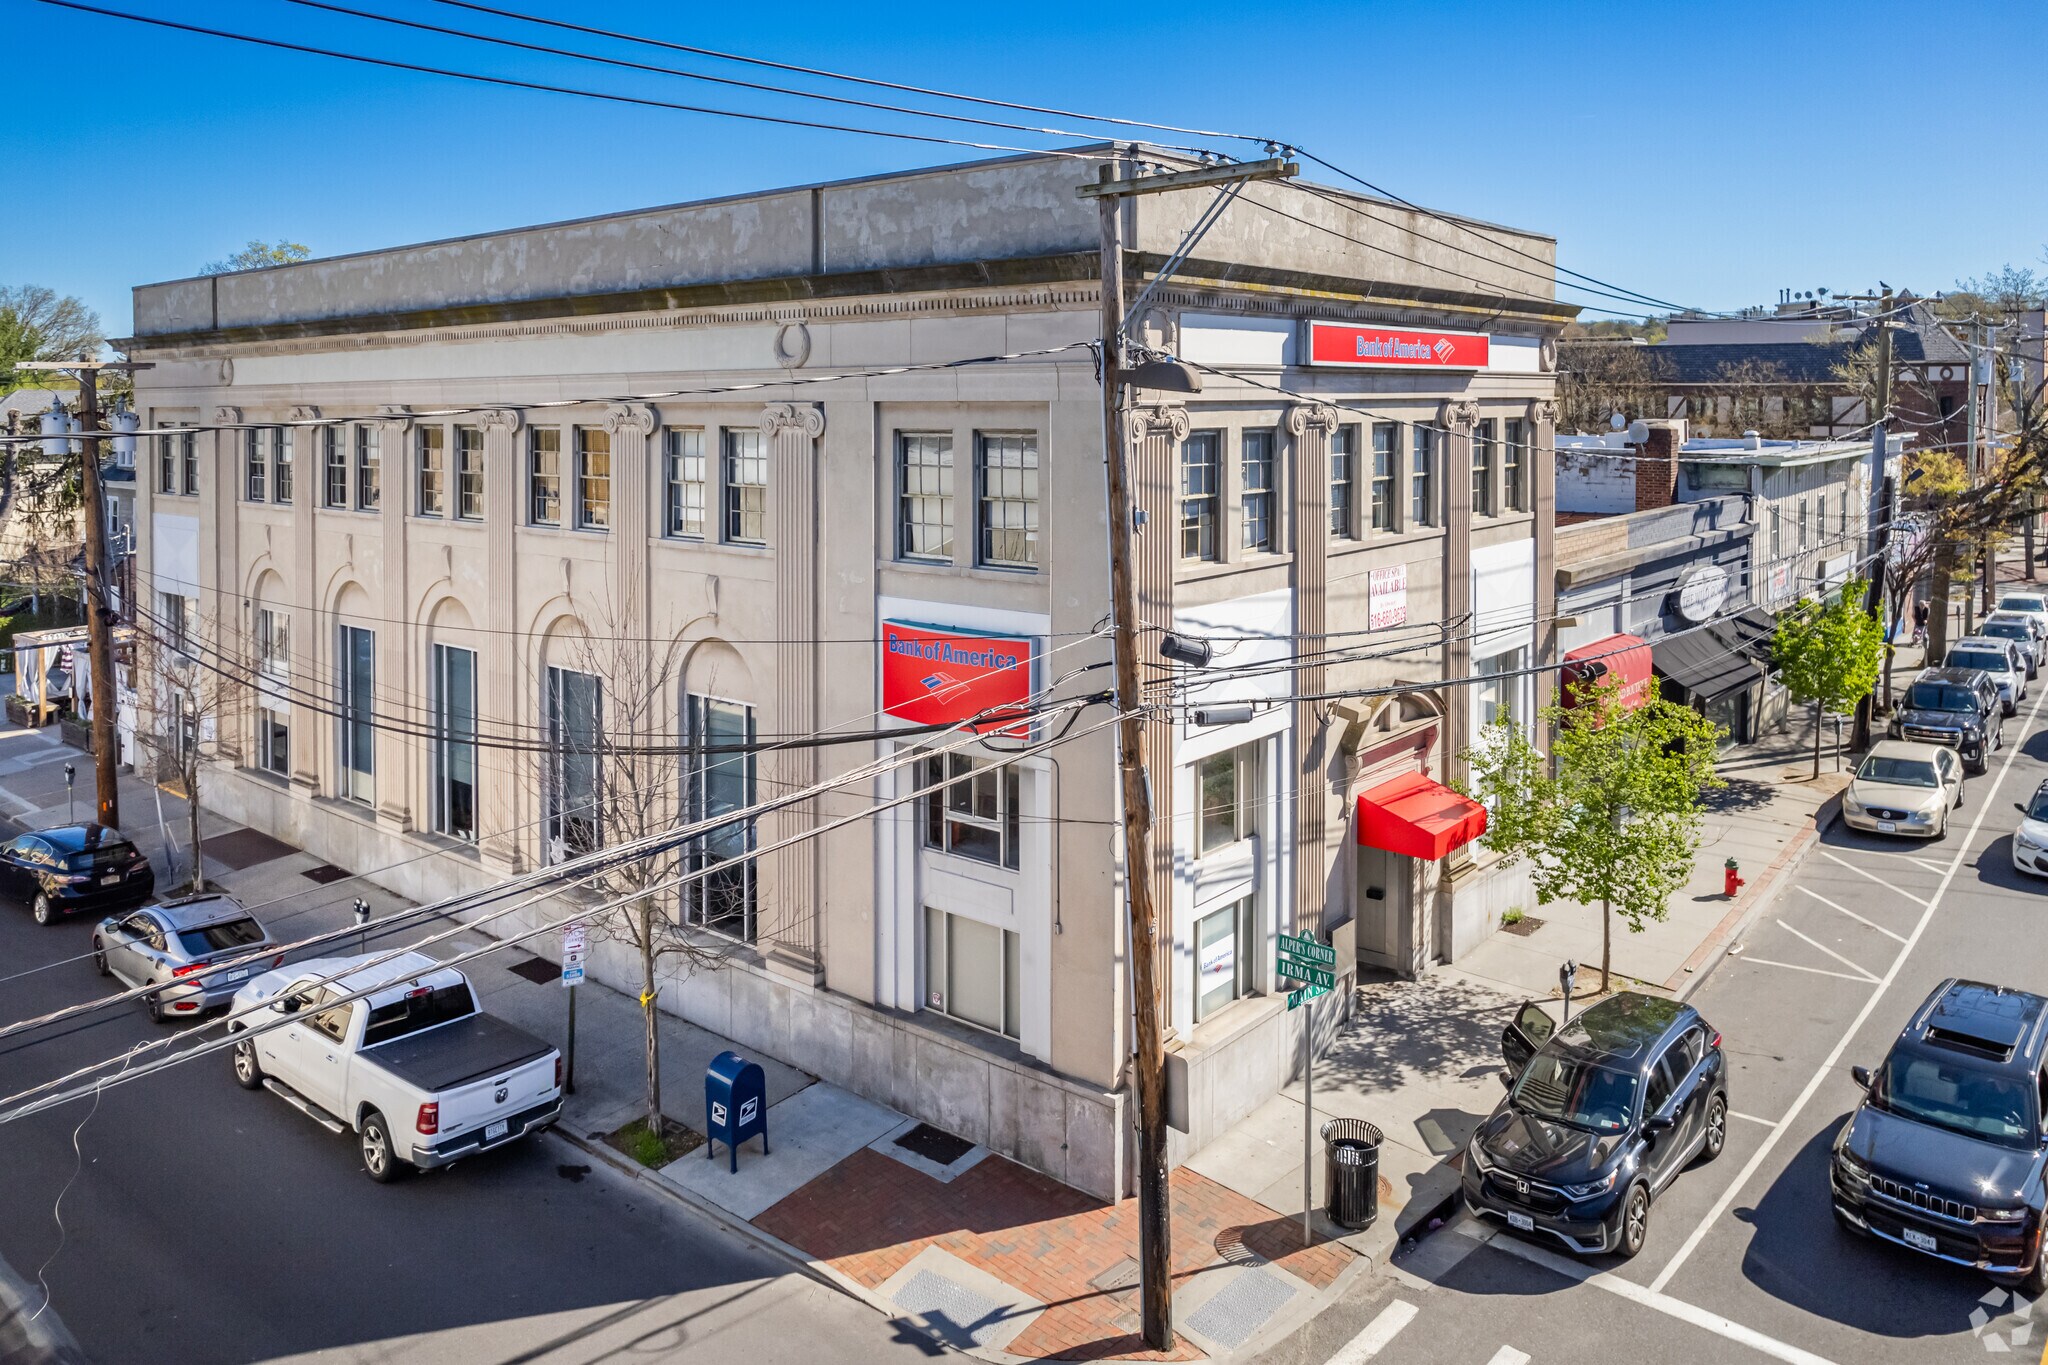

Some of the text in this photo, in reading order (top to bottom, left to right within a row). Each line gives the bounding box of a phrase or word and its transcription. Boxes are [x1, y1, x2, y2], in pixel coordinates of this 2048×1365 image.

[1357, 335, 1431, 359] Bank of America
[1371, 576, 1407, 598] AVAILABLE
[1682, 592, 1695, 609] THE
[889, 633, 1018, 671] Bank of America
[1203, 959, 1214, 970] Bank
[1217, 949, 1233, 961] America
[1280, 937, 1334, 964] ALPER'S CORNER
[1281, 961, 1331, 988] IRMA AV.
[1291, 985, 1313, 1007] MAIN
